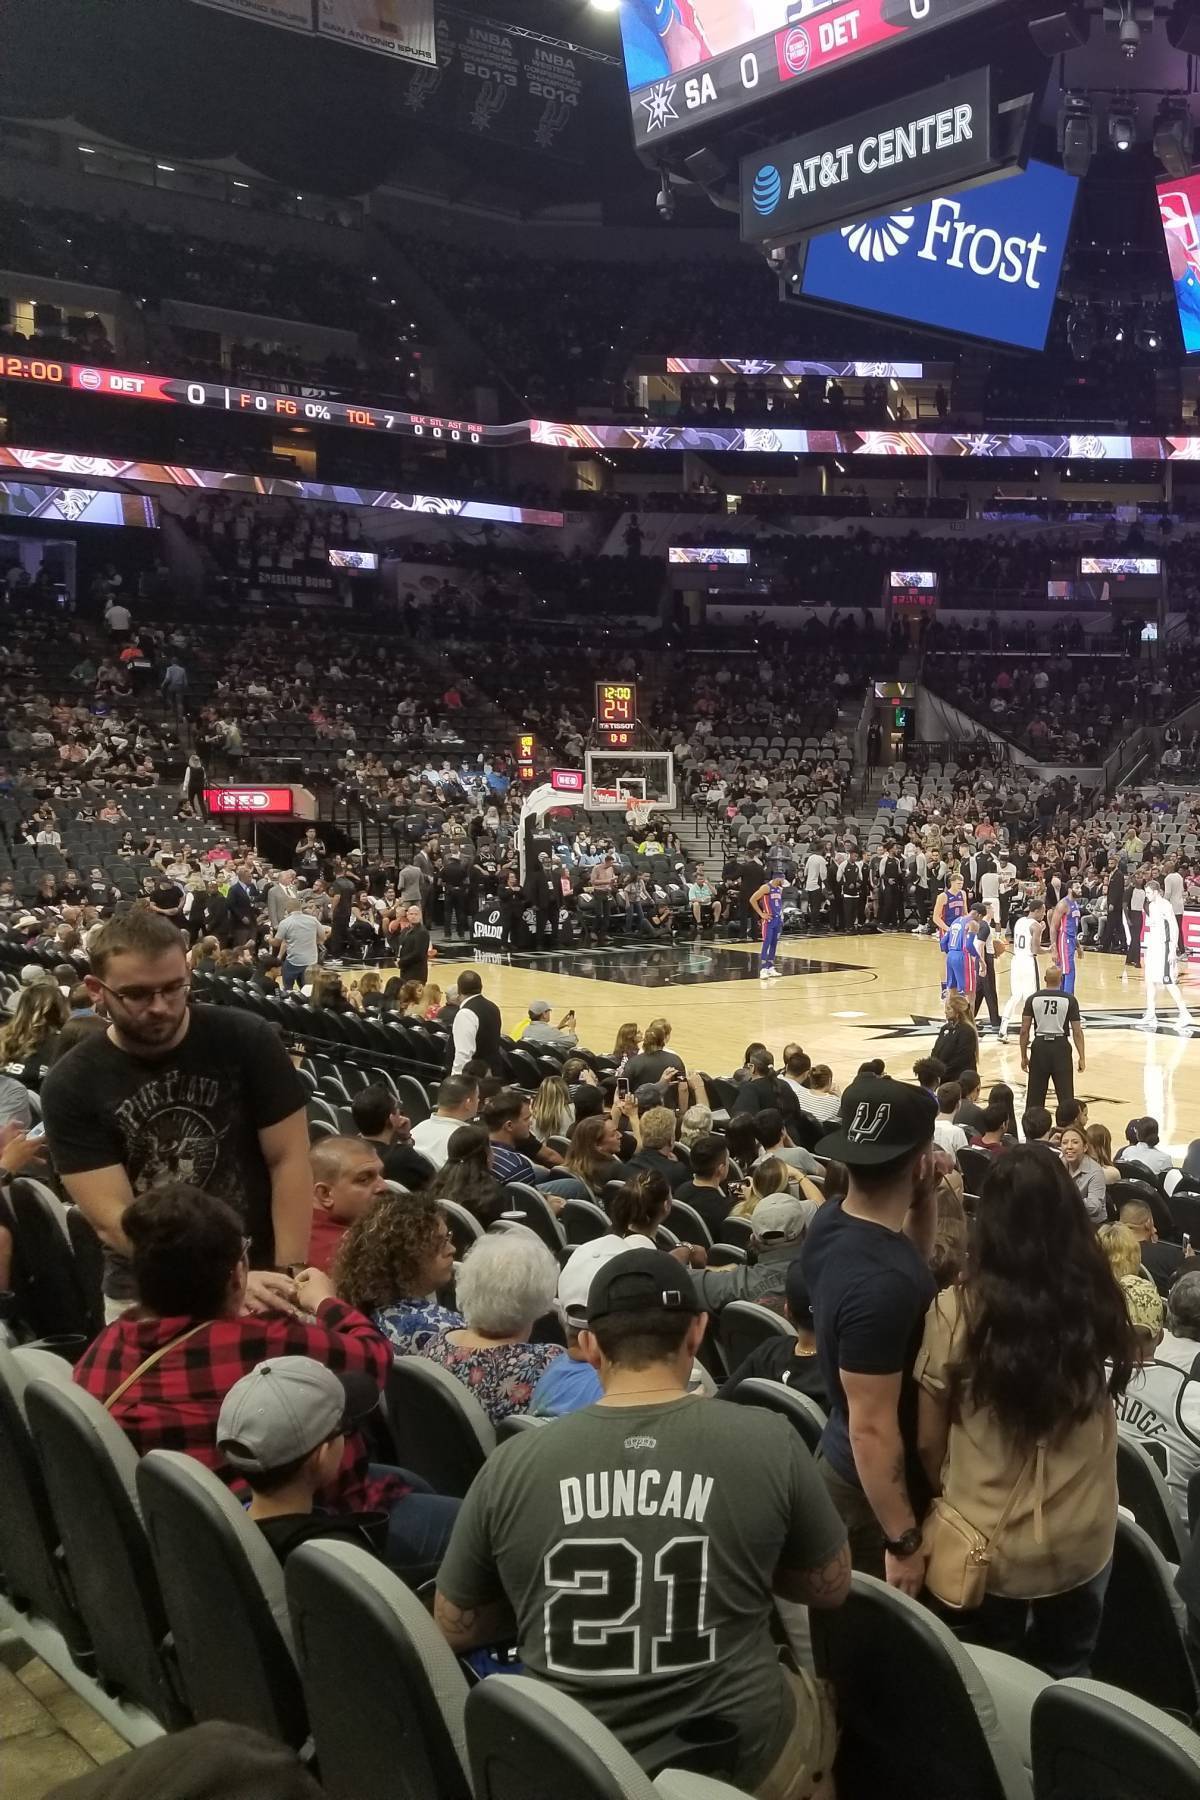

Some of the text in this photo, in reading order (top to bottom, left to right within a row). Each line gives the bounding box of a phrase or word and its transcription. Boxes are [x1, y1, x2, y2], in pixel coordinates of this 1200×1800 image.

[323, 21, 432, 59] SAN ANTONIO SPURS
[532, 58, 576, 79] WESTERN
[684, 72, 717, 109] SA
[740, 53, 758, 88] 0
[818, 9, 860, 52] DET
[464, 62, 518, 87] 2013
[524, 64, 583, 88] CONFERENCE
[529, 82, 579, 107] 2014
[787, 103, 973, 200] AT&T CENTER
[917, 197, 1047, 289] Frost
[0, 356, 62, 382] 12:00
[109, 375, 145, 393] DET
[187, 384, 206, 405] 0
[240, 394, 251, 408] F
[255, 396, 267, 411] 0
[276, 399, 297, 415] FG
[305, 403, 331, 420] 0%
[347, 409, 375, 426] TOL
[384, 415, 394, 429] 7
[411, 415, 426, 424] BLK
[430, 418, 444, 427] STL
[448, 421, 462, 430] AST
[414, 425, 480, 443] 0 0 0 0
[604, 687, 631, 700] 12:00
[604, 699, 629, 719] 24
[1043, 999, 1058, 1015] 73
[559, 1469, 715, 1525] DUNCAN
[544, 1536, 716, 1676] 21
